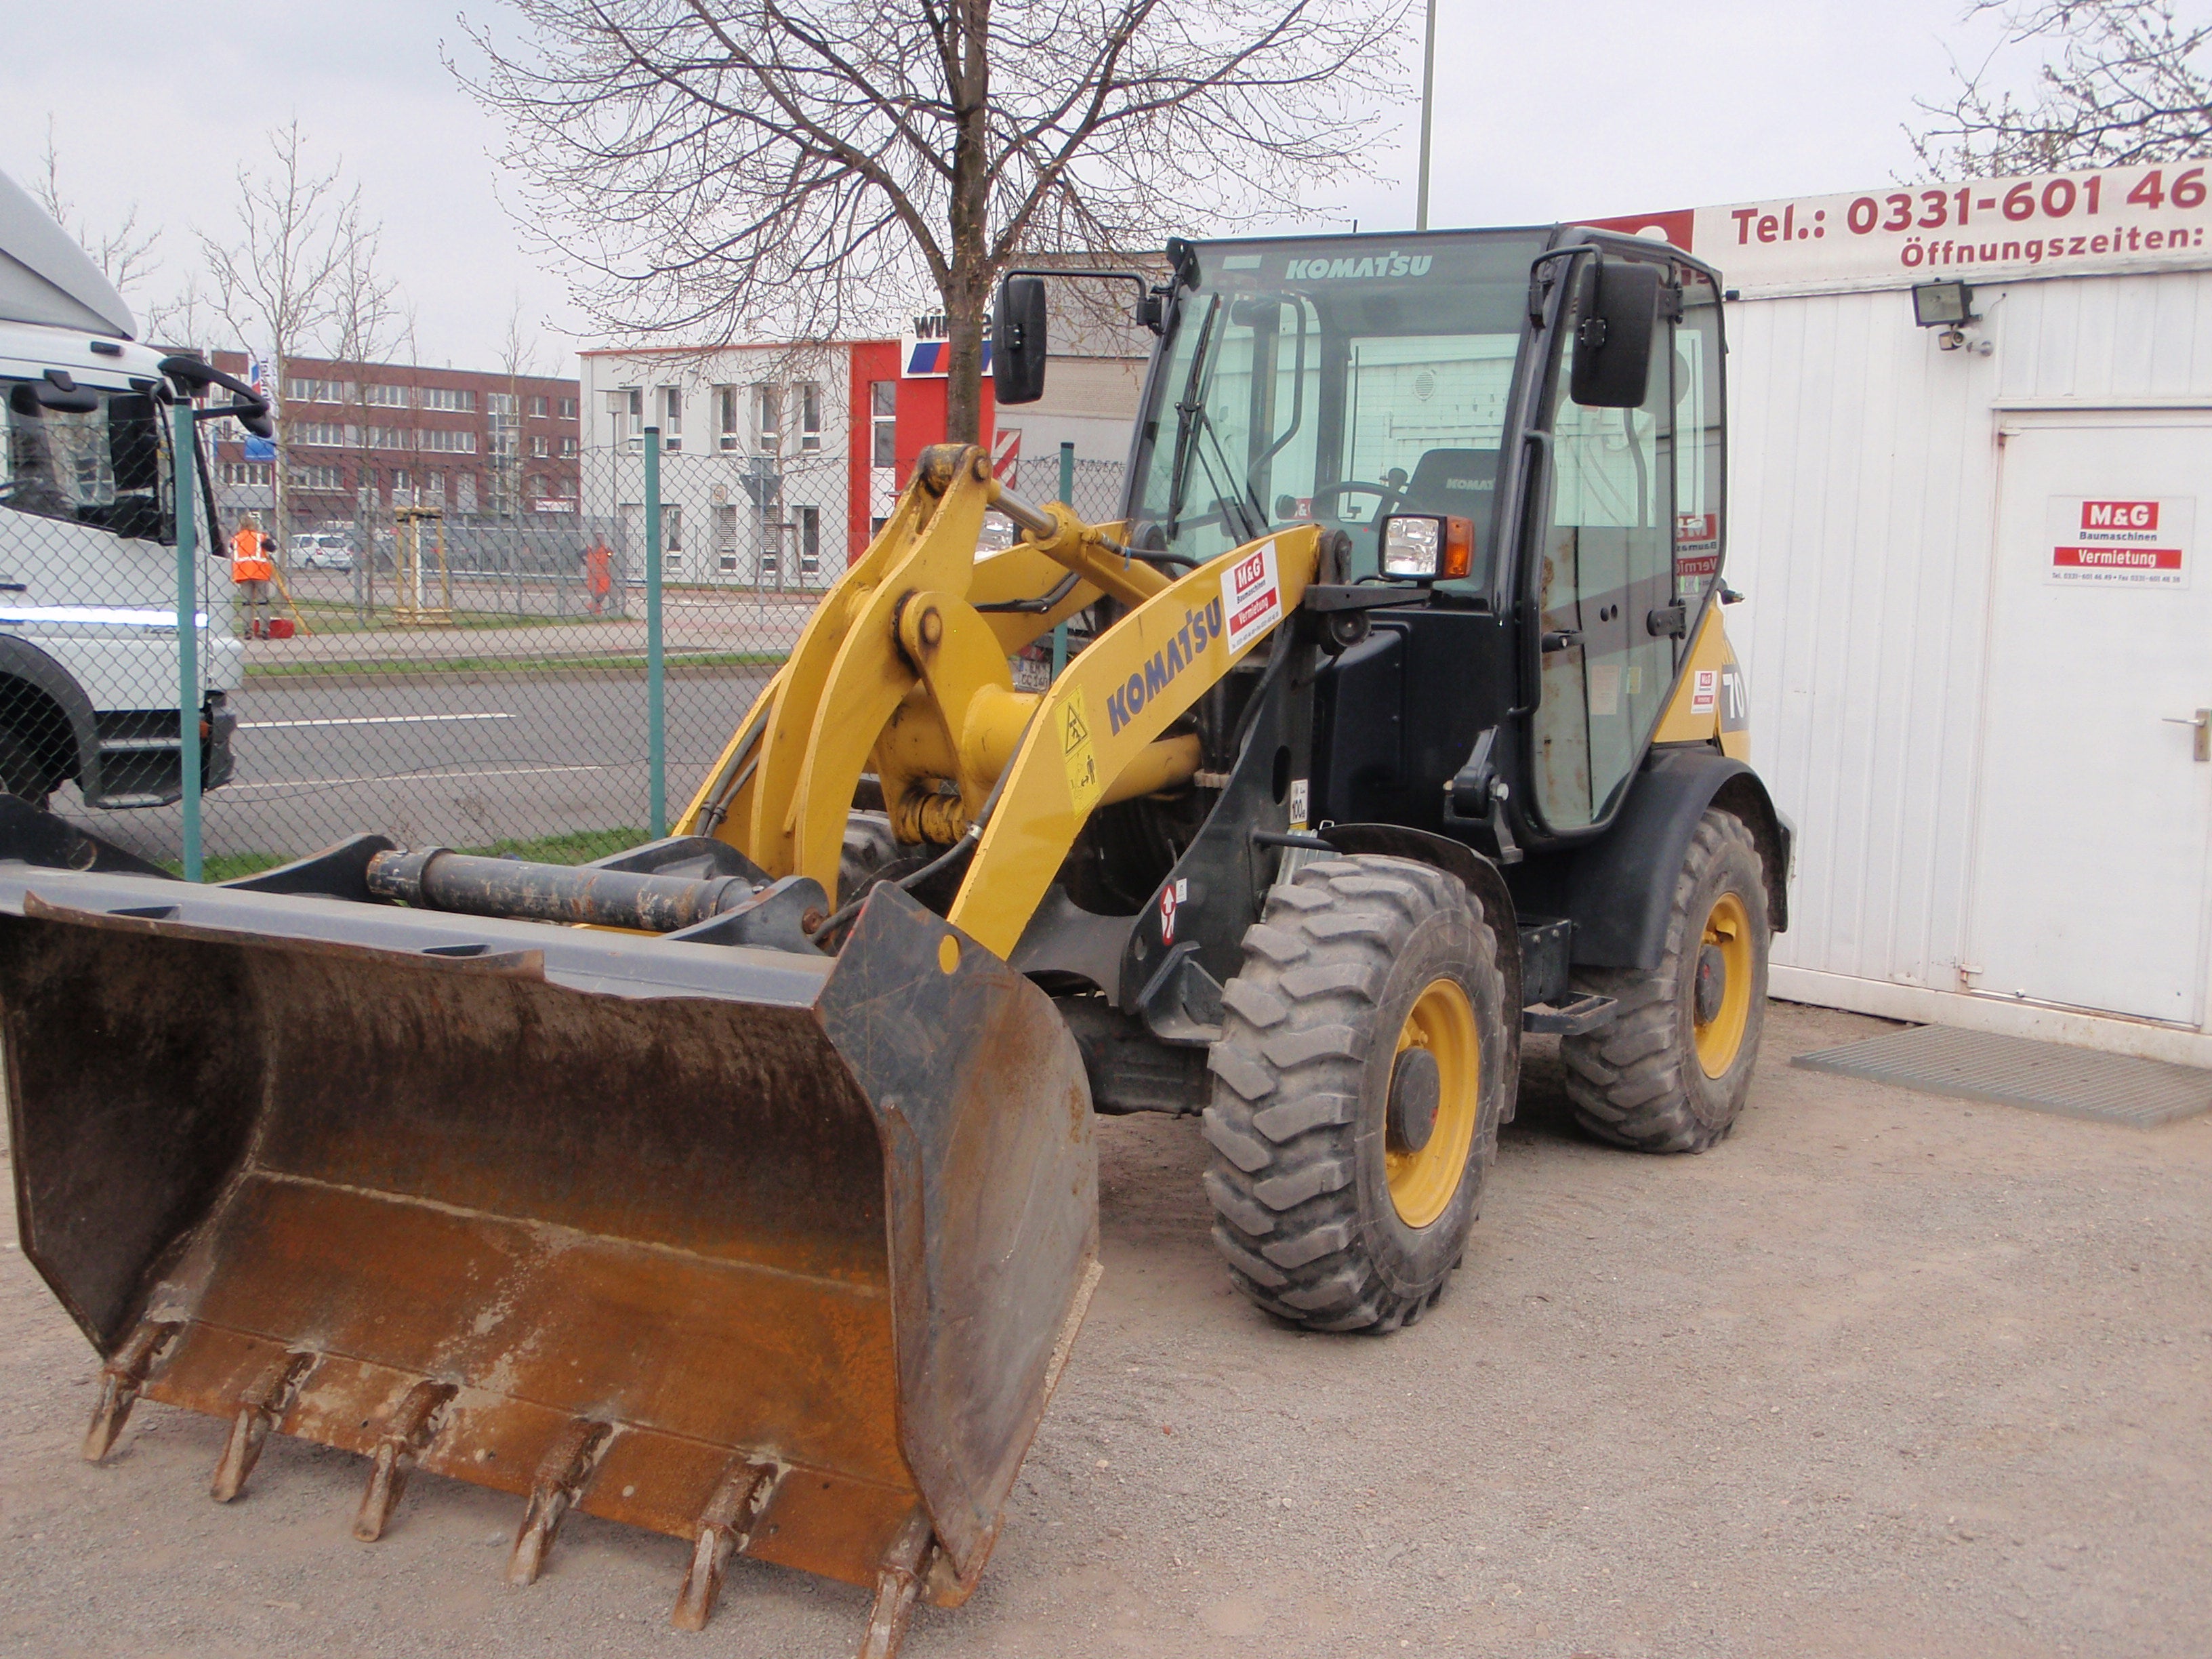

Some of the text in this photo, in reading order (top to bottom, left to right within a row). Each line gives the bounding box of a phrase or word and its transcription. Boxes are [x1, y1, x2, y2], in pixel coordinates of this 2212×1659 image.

[1731, 167, 2208, 245] Tel.: 0331-601 46
[1900, 225, 2204, 267] Öffnungszeiten:
[1286, 251, 1433, 279] KOMATSU
[1445, 477, 1496, 491] KOMAT
[2090, 504, 2150, 527] M&G
[2079, 531, 2158, 541] Baumaschinen
[1237, 557, 1261, 588] M&G
[2078, 548, 2157, 569] Vermietung
[1236, 579, 1267, 605] Baumaschinen
[1237, 596, 1269, 625] Vermietung
[1107, 595, 1221, 737] KOMATSU
